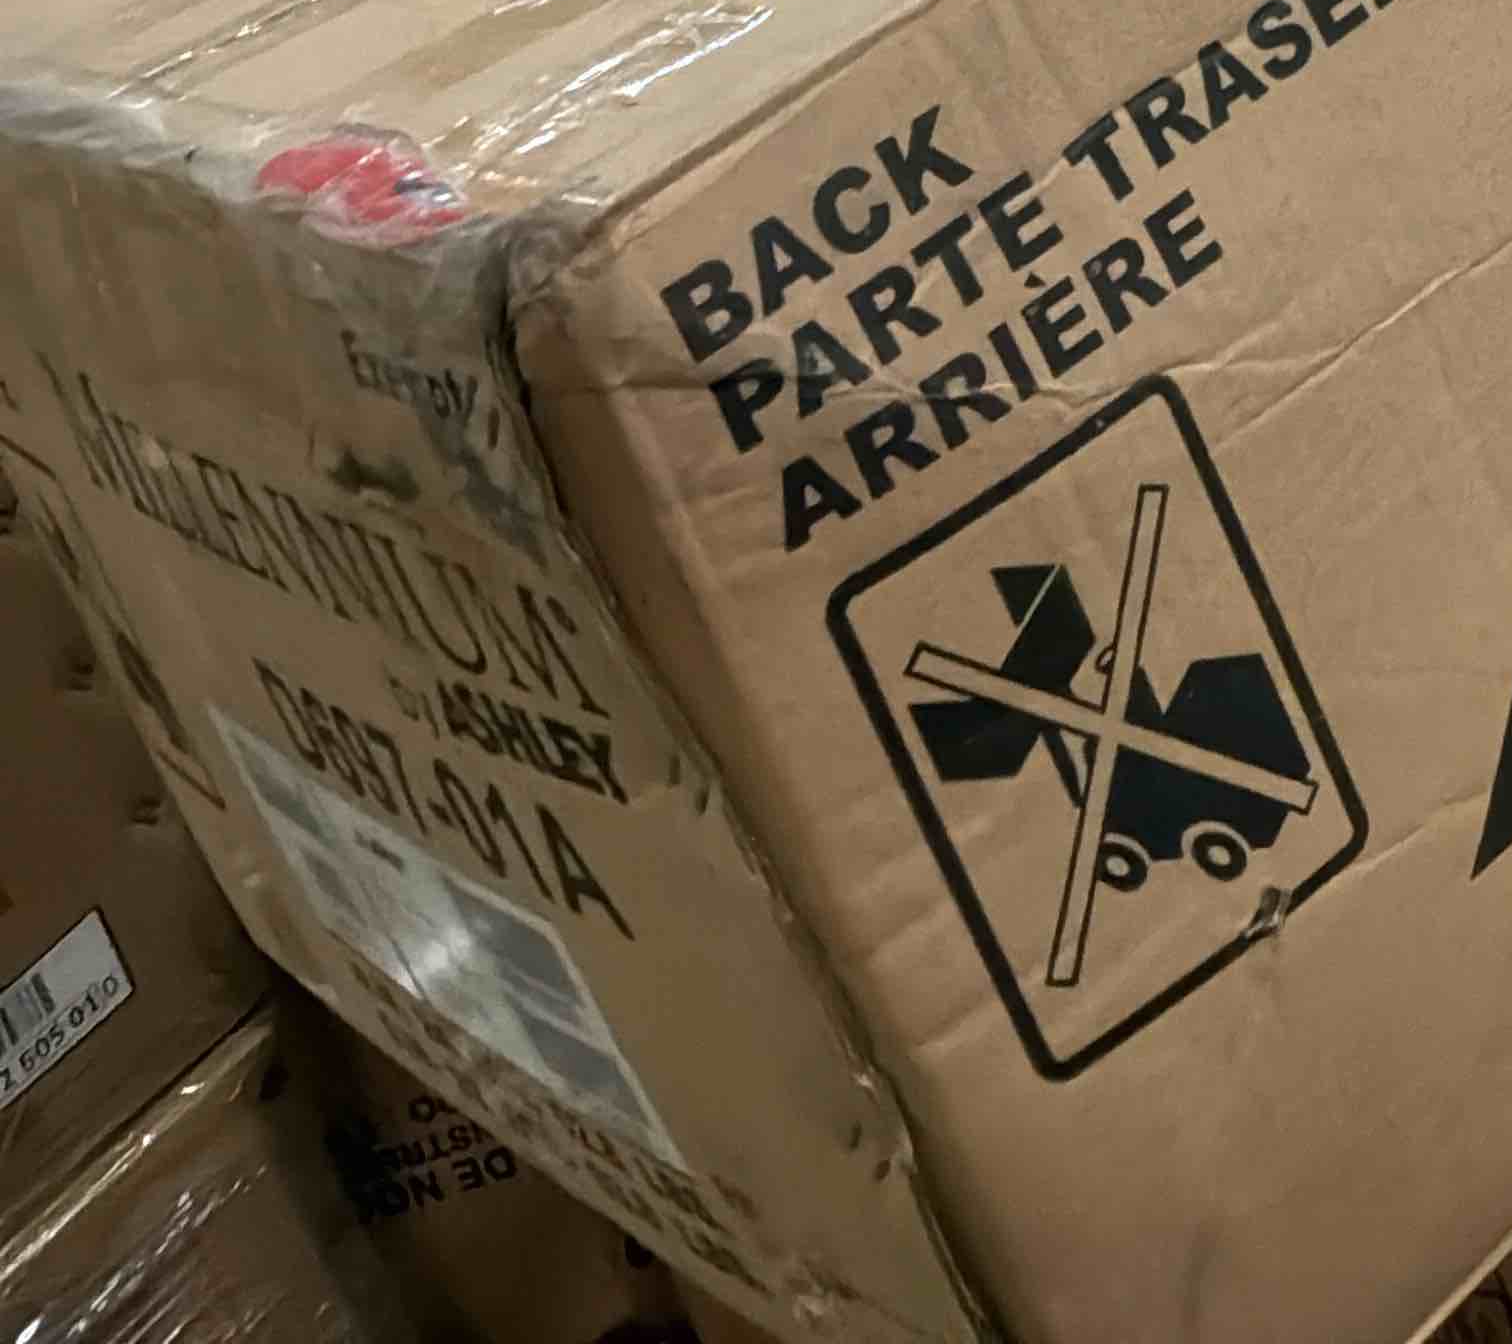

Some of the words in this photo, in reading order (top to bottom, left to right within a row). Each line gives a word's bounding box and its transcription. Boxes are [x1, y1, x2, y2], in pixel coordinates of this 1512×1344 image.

[660, 104, 974, 364] BACK
[708, 171, 1065, 454] PARTE
[783, 189, 1224, 553] ARRIÈRE
[252, 656, 636, 942] D697-01A
[436, 679, 628, 806] ASHLEY
